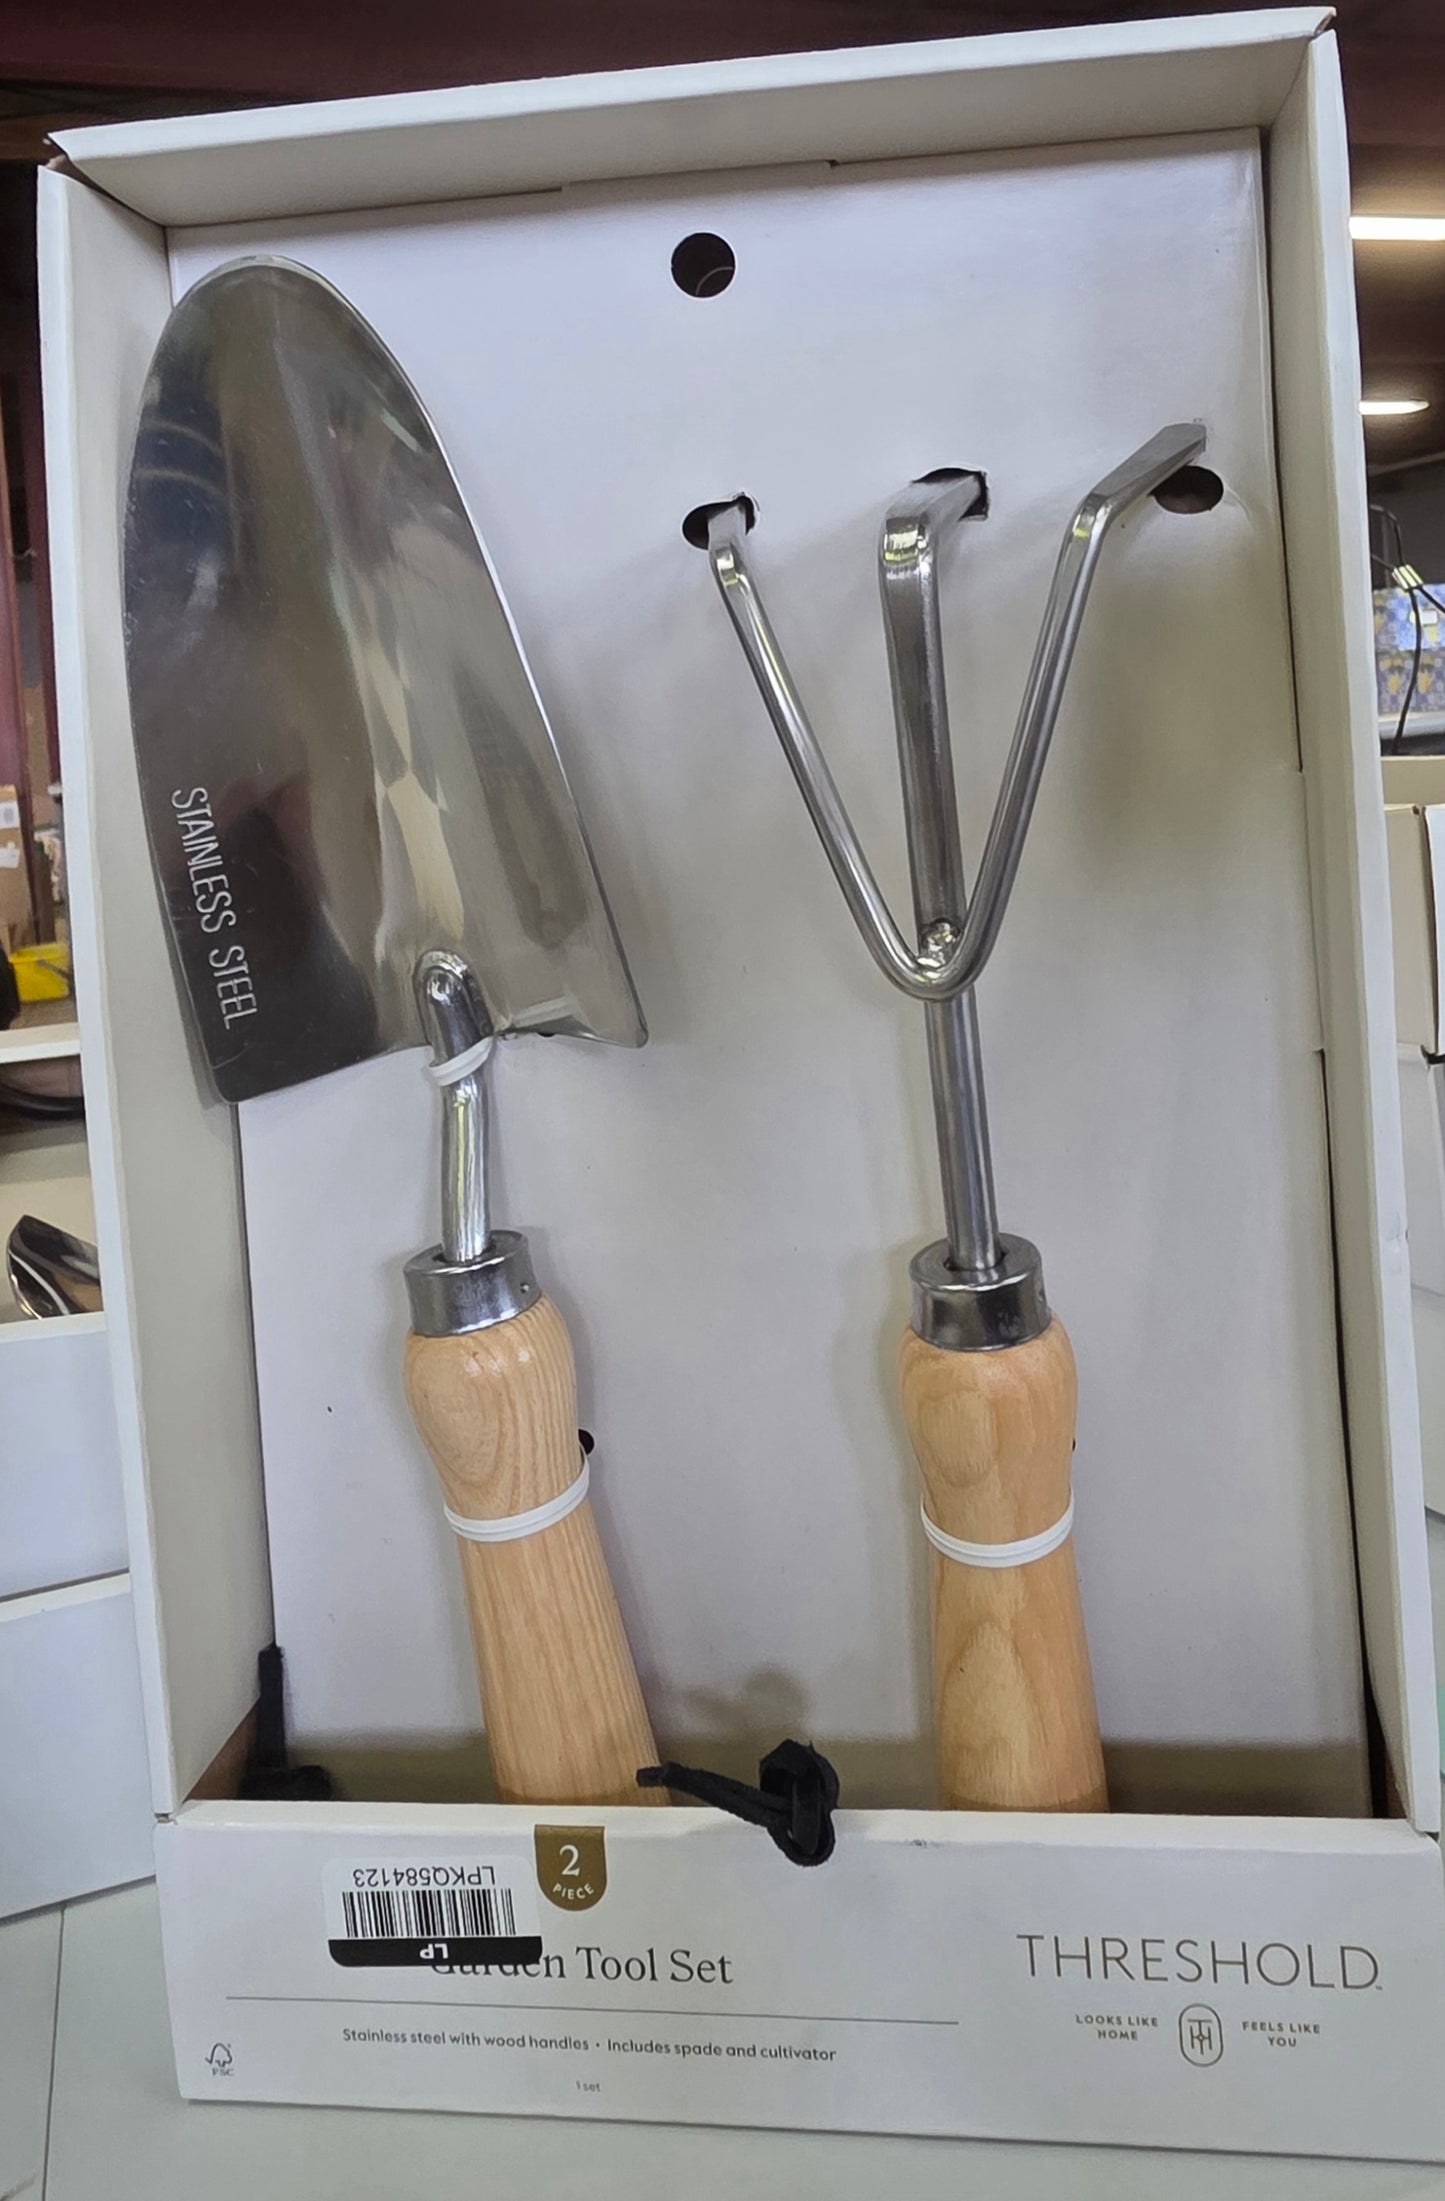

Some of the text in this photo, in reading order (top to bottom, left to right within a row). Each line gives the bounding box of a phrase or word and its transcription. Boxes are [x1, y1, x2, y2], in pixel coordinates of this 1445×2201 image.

[171, 787, 258, 1029] STAINLESS STEEL
[559, 1844, 580, 1876] 2
[352, 1865, 496, 1888] LPKQ584123
[552, 1882, 595, 1900] PIECE
[419, 1943, 449, 1959] LP
[575, 1946, 658, 1982] Tool
[670, 1949, 734, 1984] Set
[1016, 1934, 1380, 1990] THRESHOLD
[1075, 2014, 1158, 2027] LOOKS LIKE
[1242, 2021, 1321, 2034] FEELS LIKE
[342, 2028, 837, 2061] Stainless steel with wood handles Includes spade and cultivator
[1097, 2030, 1138, 2041] HOME
[1268, 2036, 1297, 2047] YOU
[583, 2082, 601, 2092] set
